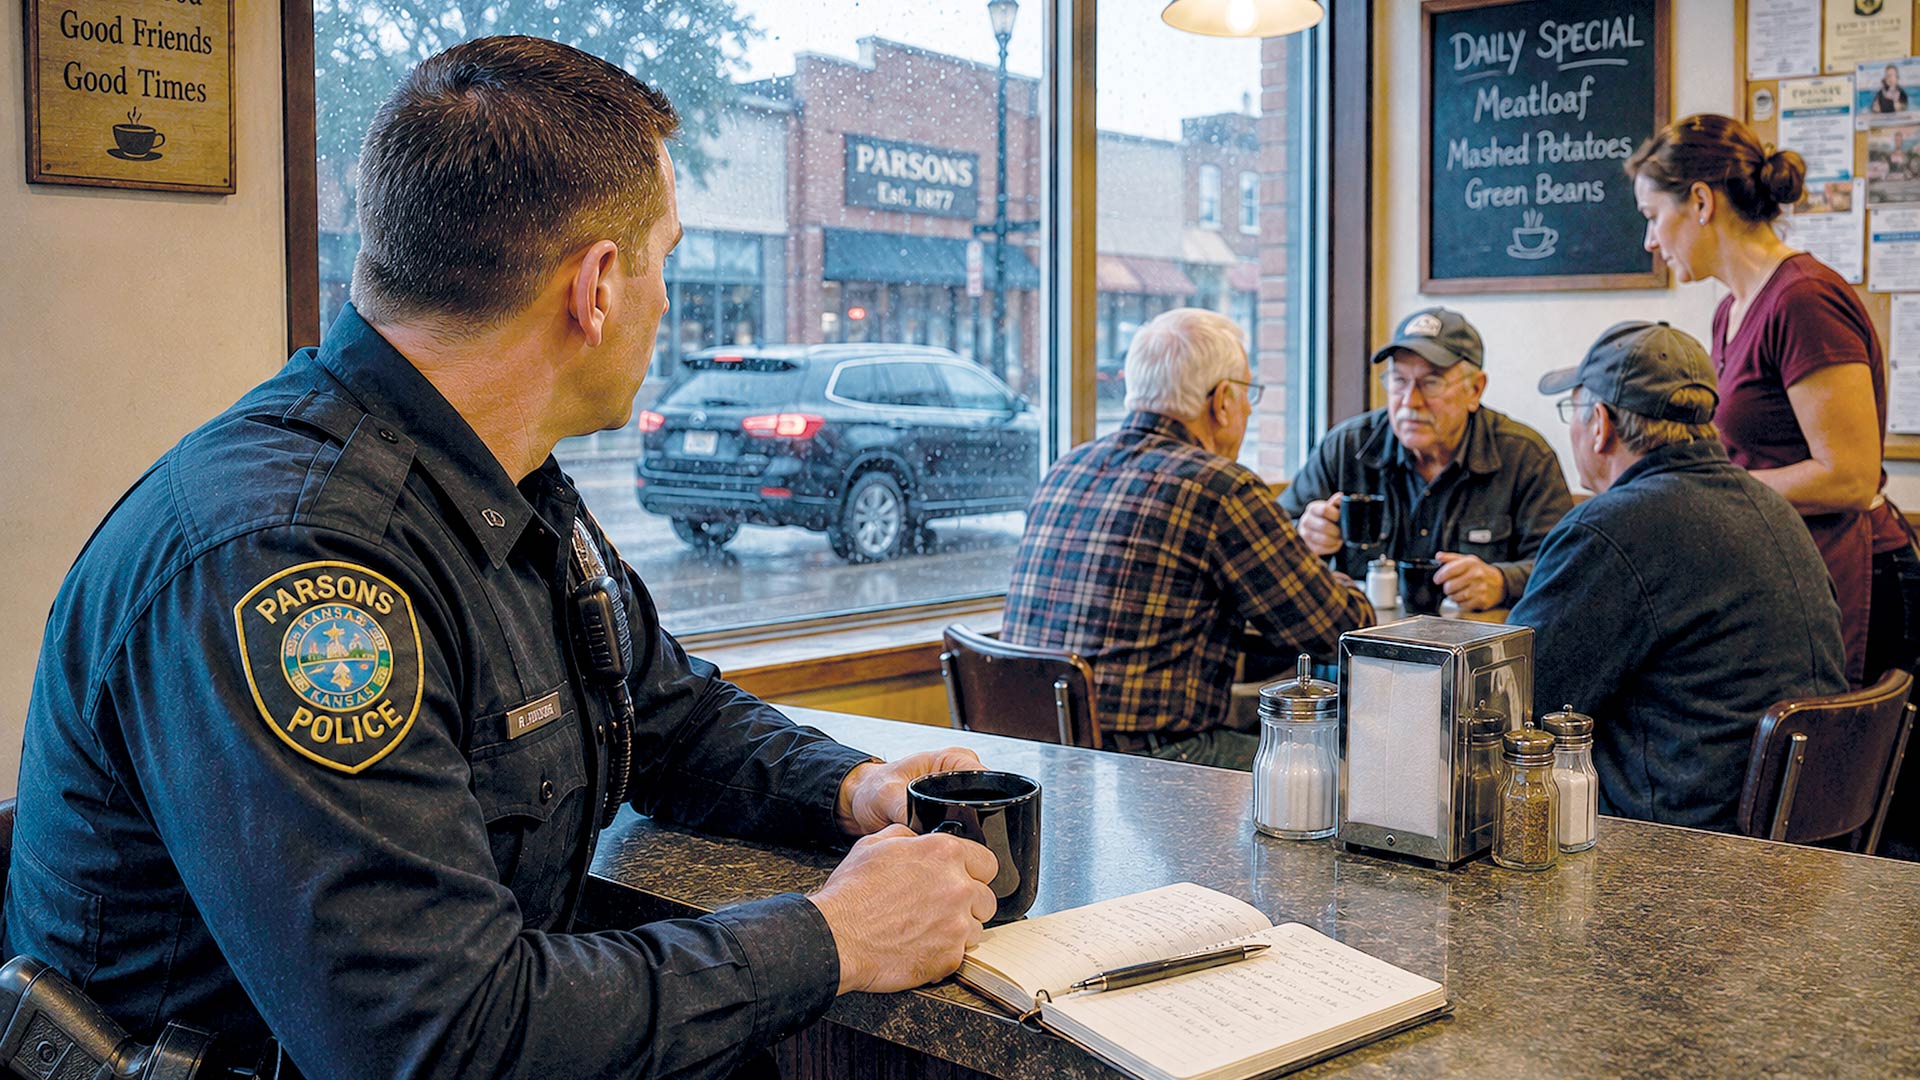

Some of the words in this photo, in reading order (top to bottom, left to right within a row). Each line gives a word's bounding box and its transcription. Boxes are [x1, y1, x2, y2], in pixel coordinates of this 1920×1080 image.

[60, 9, 124, 45] Good
[132, 18, 212, 55] Friends
[1450, 29, 1526, 75] DAILY
[1536, 14, 1645, 62] SPECIAL
[63, 61, 128, 95] Good
[138, 69, 207, 103] Times
[1473, 75, 1595, 123] Meatloaf
[855, 144, 974, 187] PARSONS
[1446, 132, 1530, 171] Mashed
[1536, 130, 1633, 164] Potatoes
[1464, 177, 1528, 209] Green
[1535, 173, 1605, 205] Beans
[255, 574, 395, 625] PARSONS
[310, 688, 375, 708] KANSAS
[286, 699, 403, 744] POLICE
